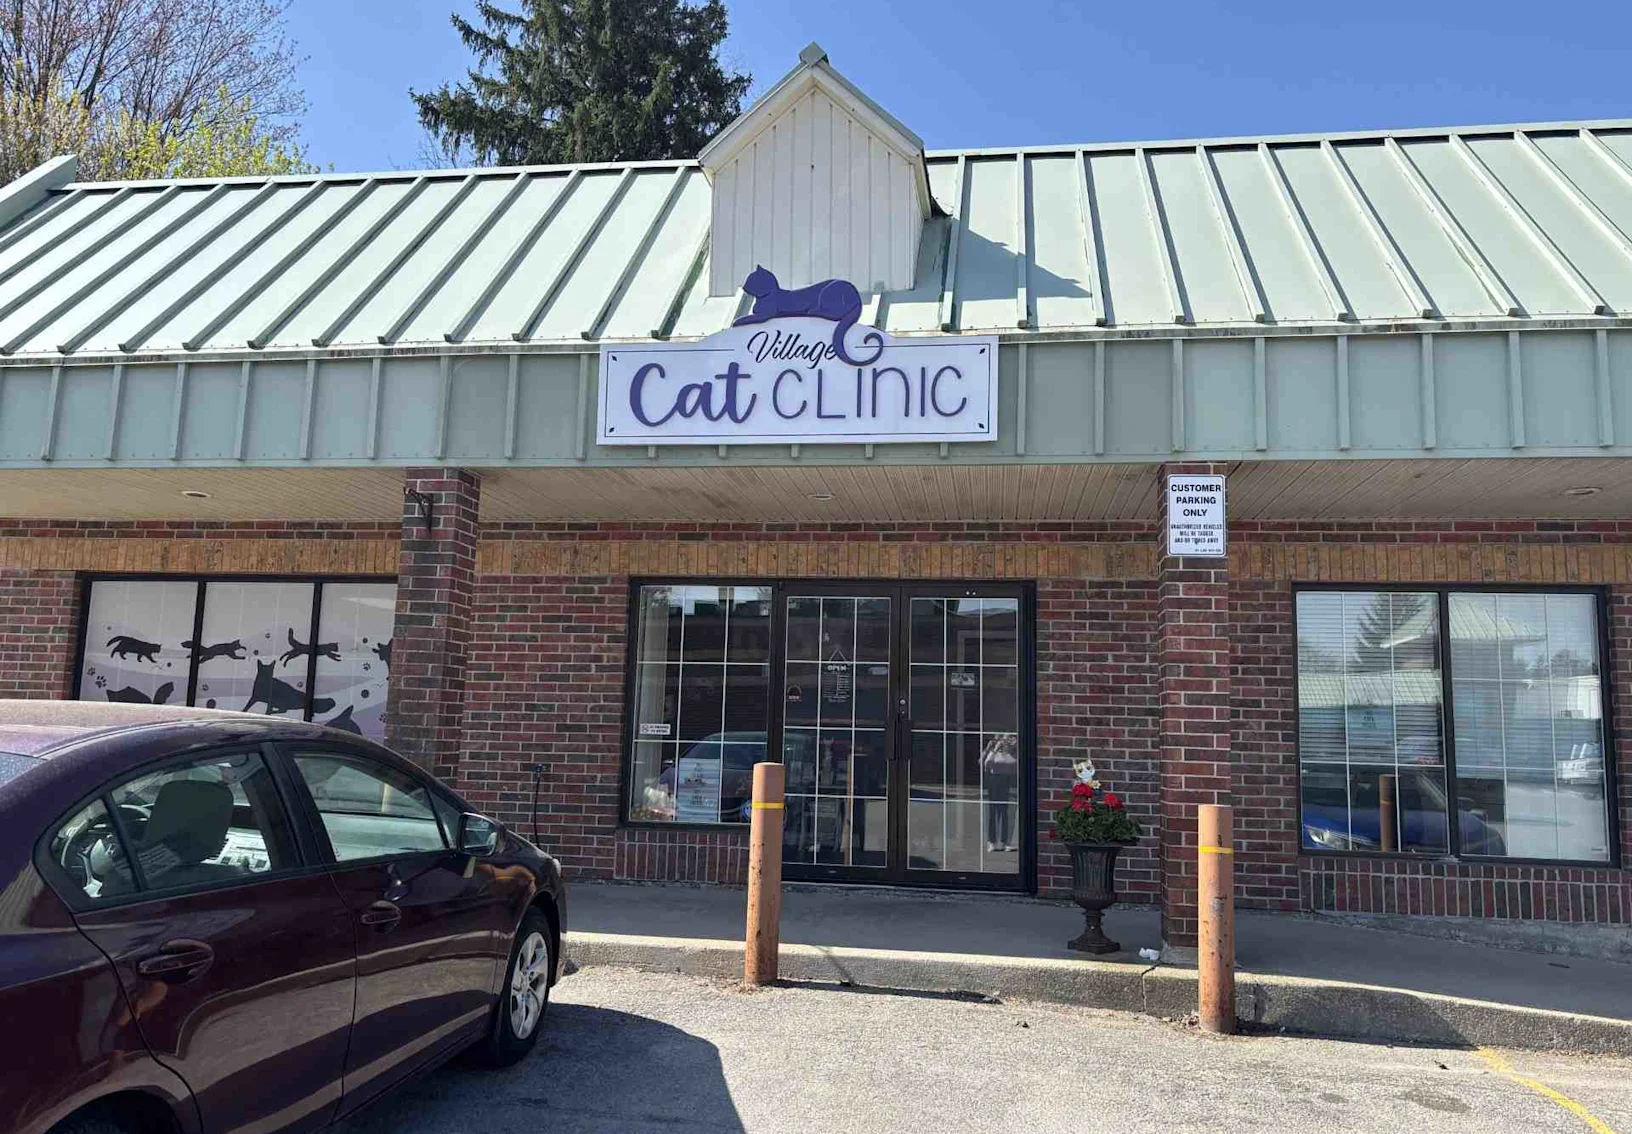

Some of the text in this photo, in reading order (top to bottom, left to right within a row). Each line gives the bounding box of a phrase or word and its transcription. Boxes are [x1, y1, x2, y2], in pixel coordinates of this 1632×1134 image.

[746, 330, 837, 369] Village
[629, 361, 757, 427] Cat
[1171, 484, 1222, 492] CUSTOMER
[1176, 496, 1216, 504] PARKING
[1183, 508, 1208, 517] ONLY
